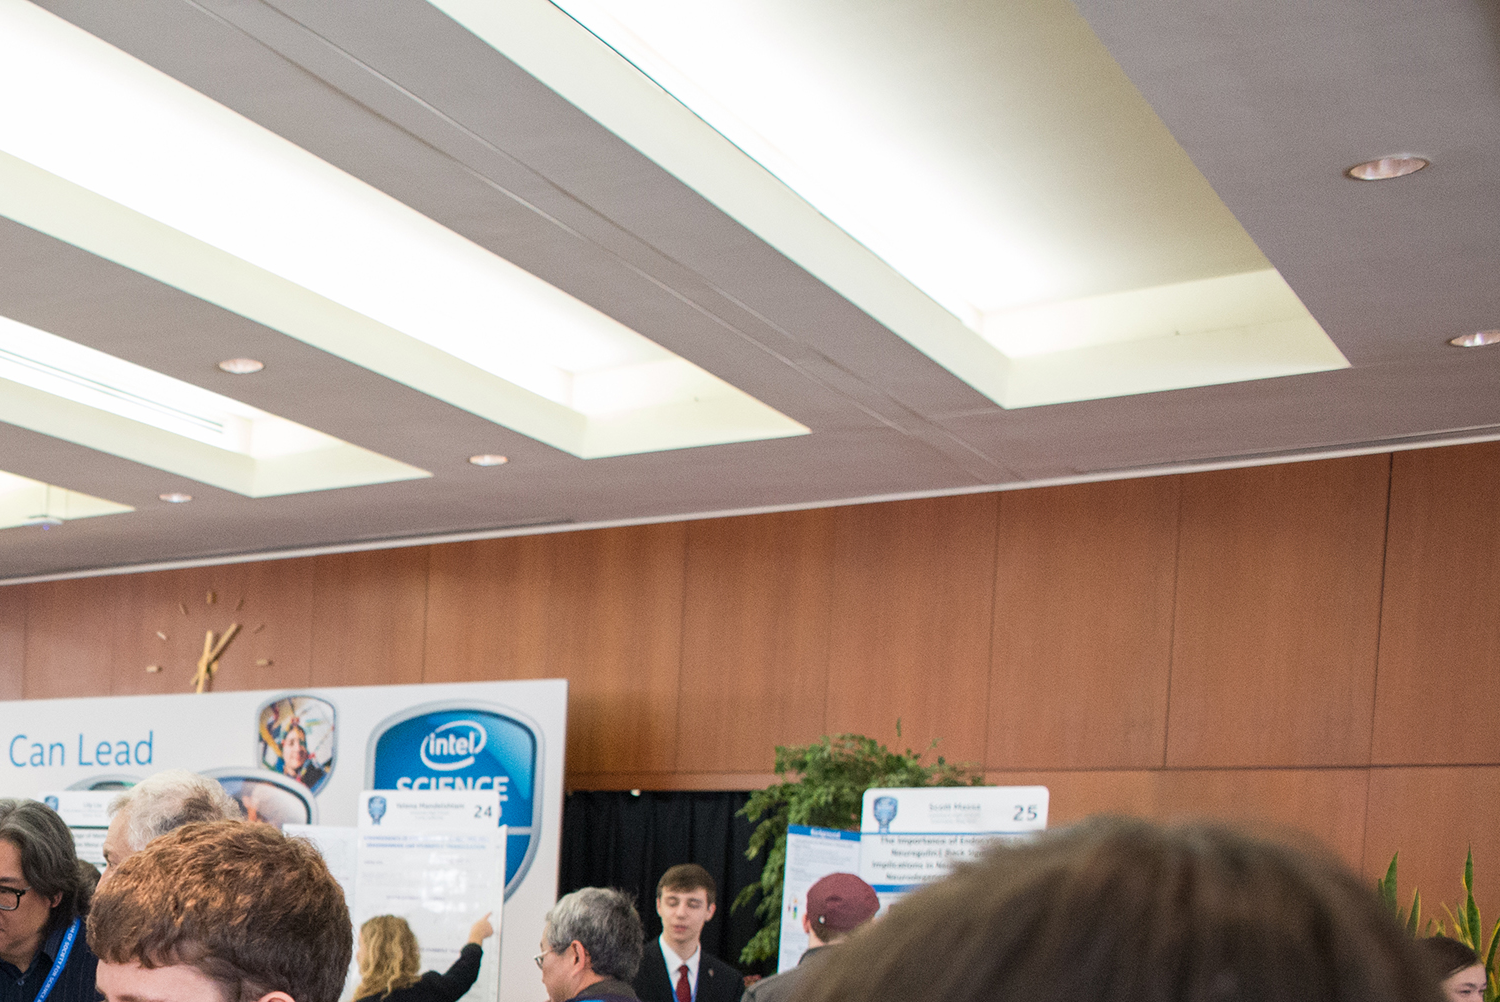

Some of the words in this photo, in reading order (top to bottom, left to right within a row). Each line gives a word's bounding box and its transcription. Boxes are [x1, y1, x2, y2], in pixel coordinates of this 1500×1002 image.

[9, 734, 64, 767] Can
[78, 730, 152, 765] Lead
[430, 731, 475, 756] intel
[473, 805, 492, 818] 24
[1013, 804, 1038, 822] 25
